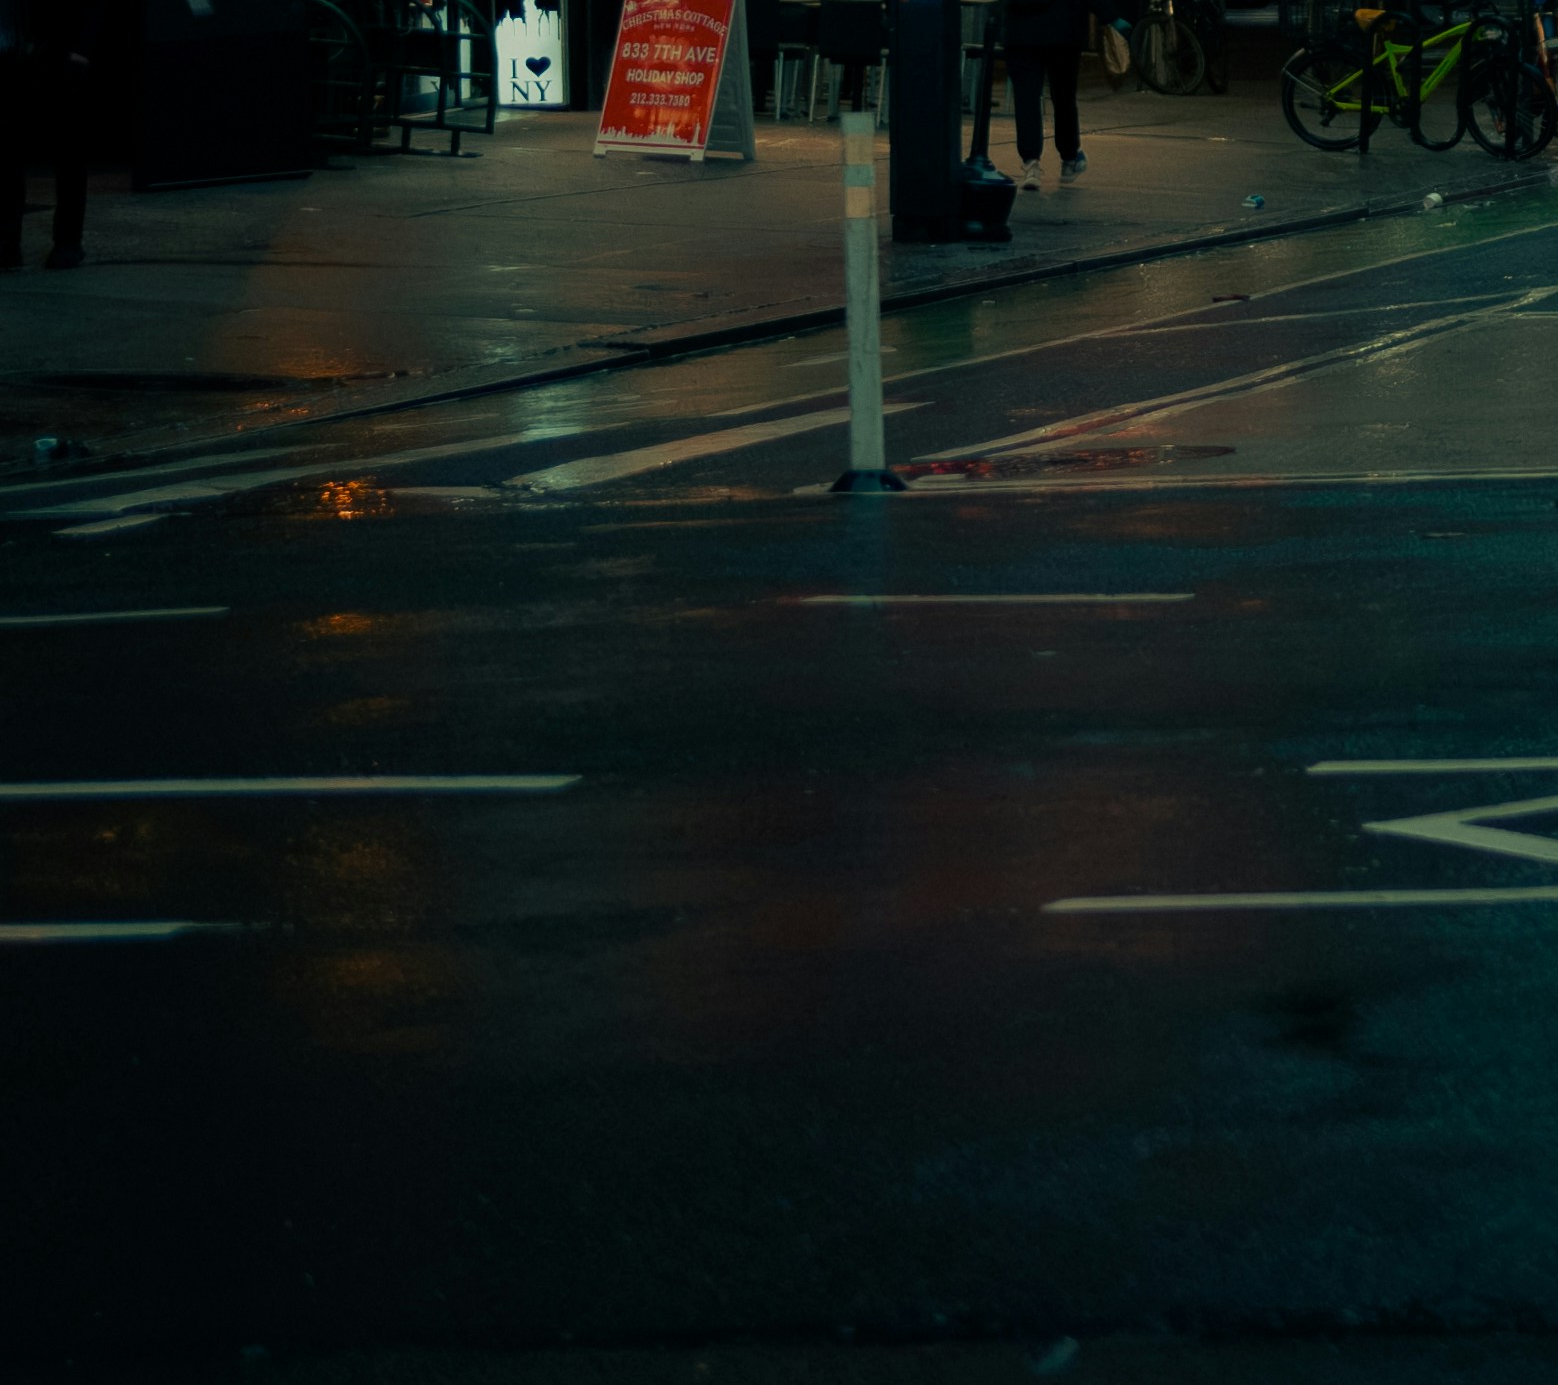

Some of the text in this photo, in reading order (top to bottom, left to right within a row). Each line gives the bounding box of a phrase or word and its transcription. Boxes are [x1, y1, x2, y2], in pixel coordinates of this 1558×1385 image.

[622, 41, 720, 64] 833 7TH AVE.
[511, 58, 519, 80] I
[626, 68, 705, 86] HOLIDAY SHOP
[511, 80, 552, 102] NY
